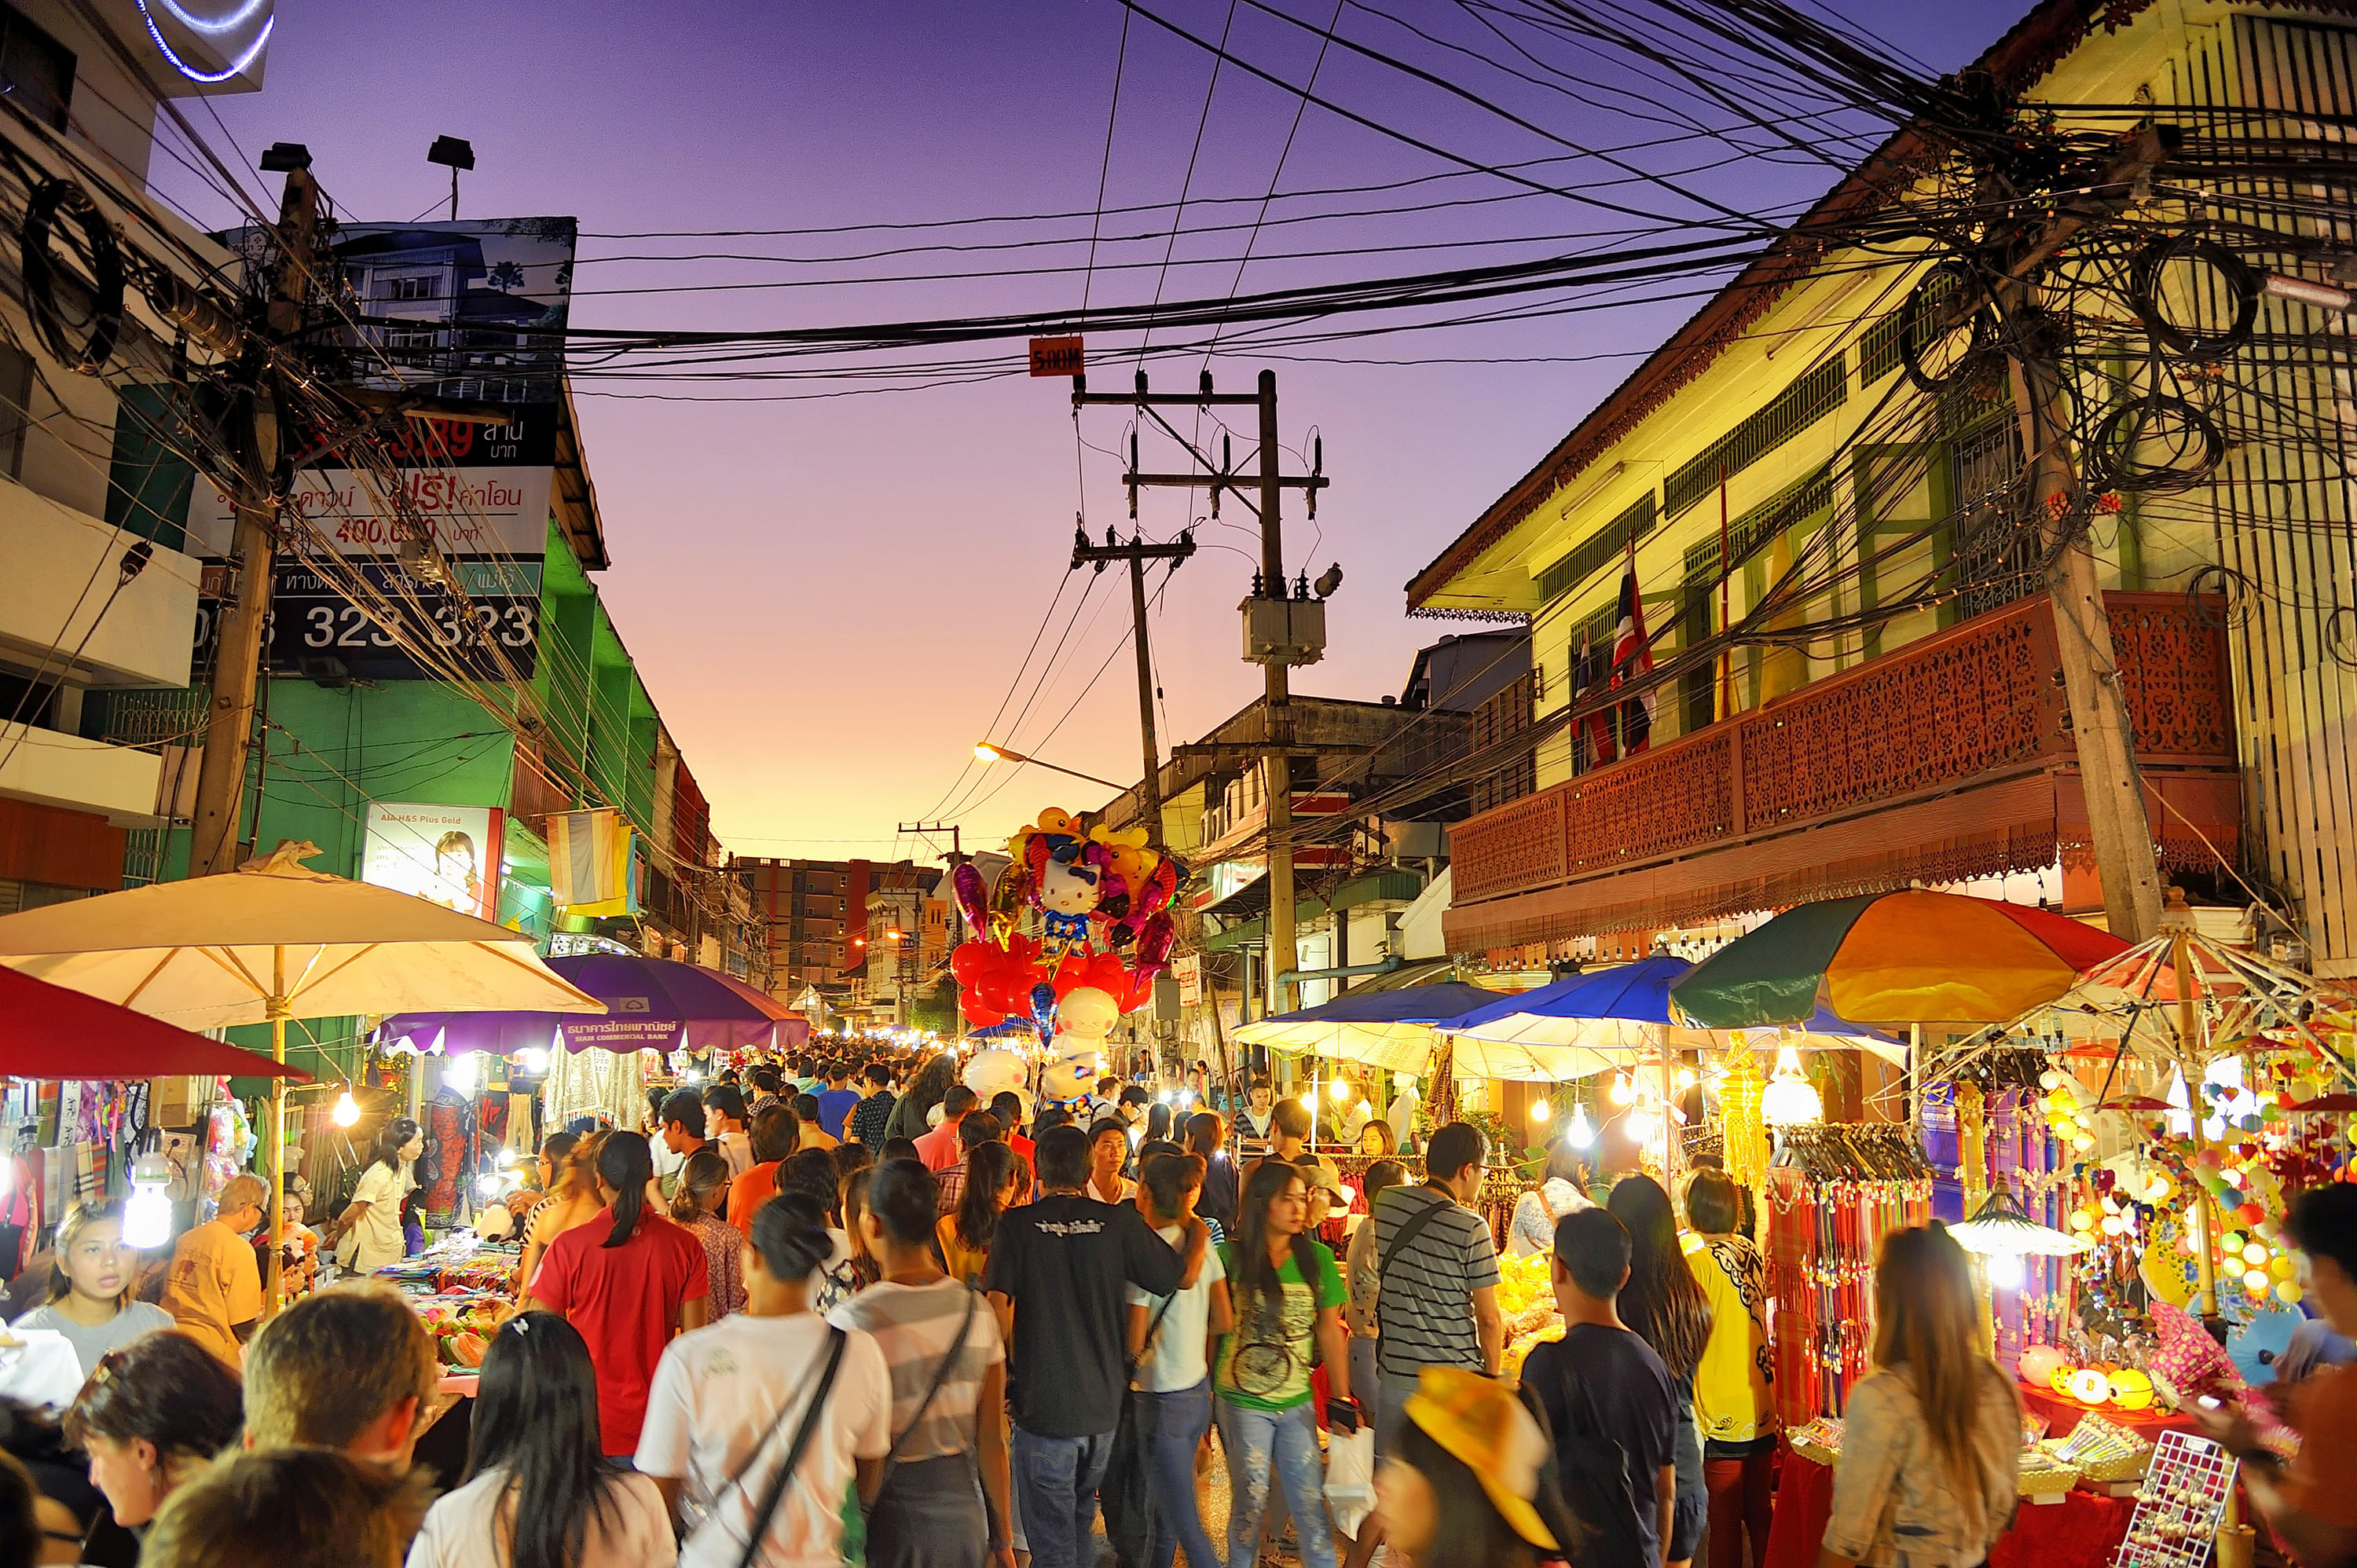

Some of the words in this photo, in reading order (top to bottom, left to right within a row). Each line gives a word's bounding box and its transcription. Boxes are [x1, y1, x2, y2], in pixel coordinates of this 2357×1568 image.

[490, 445, 516, 458] บาท
[304, 606, 403, 647] 323
[432, 605, 533, 647] 323
[442, 816, 461, 825] Gold
[567, 1020, 676, 1035] ธนาคารไทยพาณิชย์
